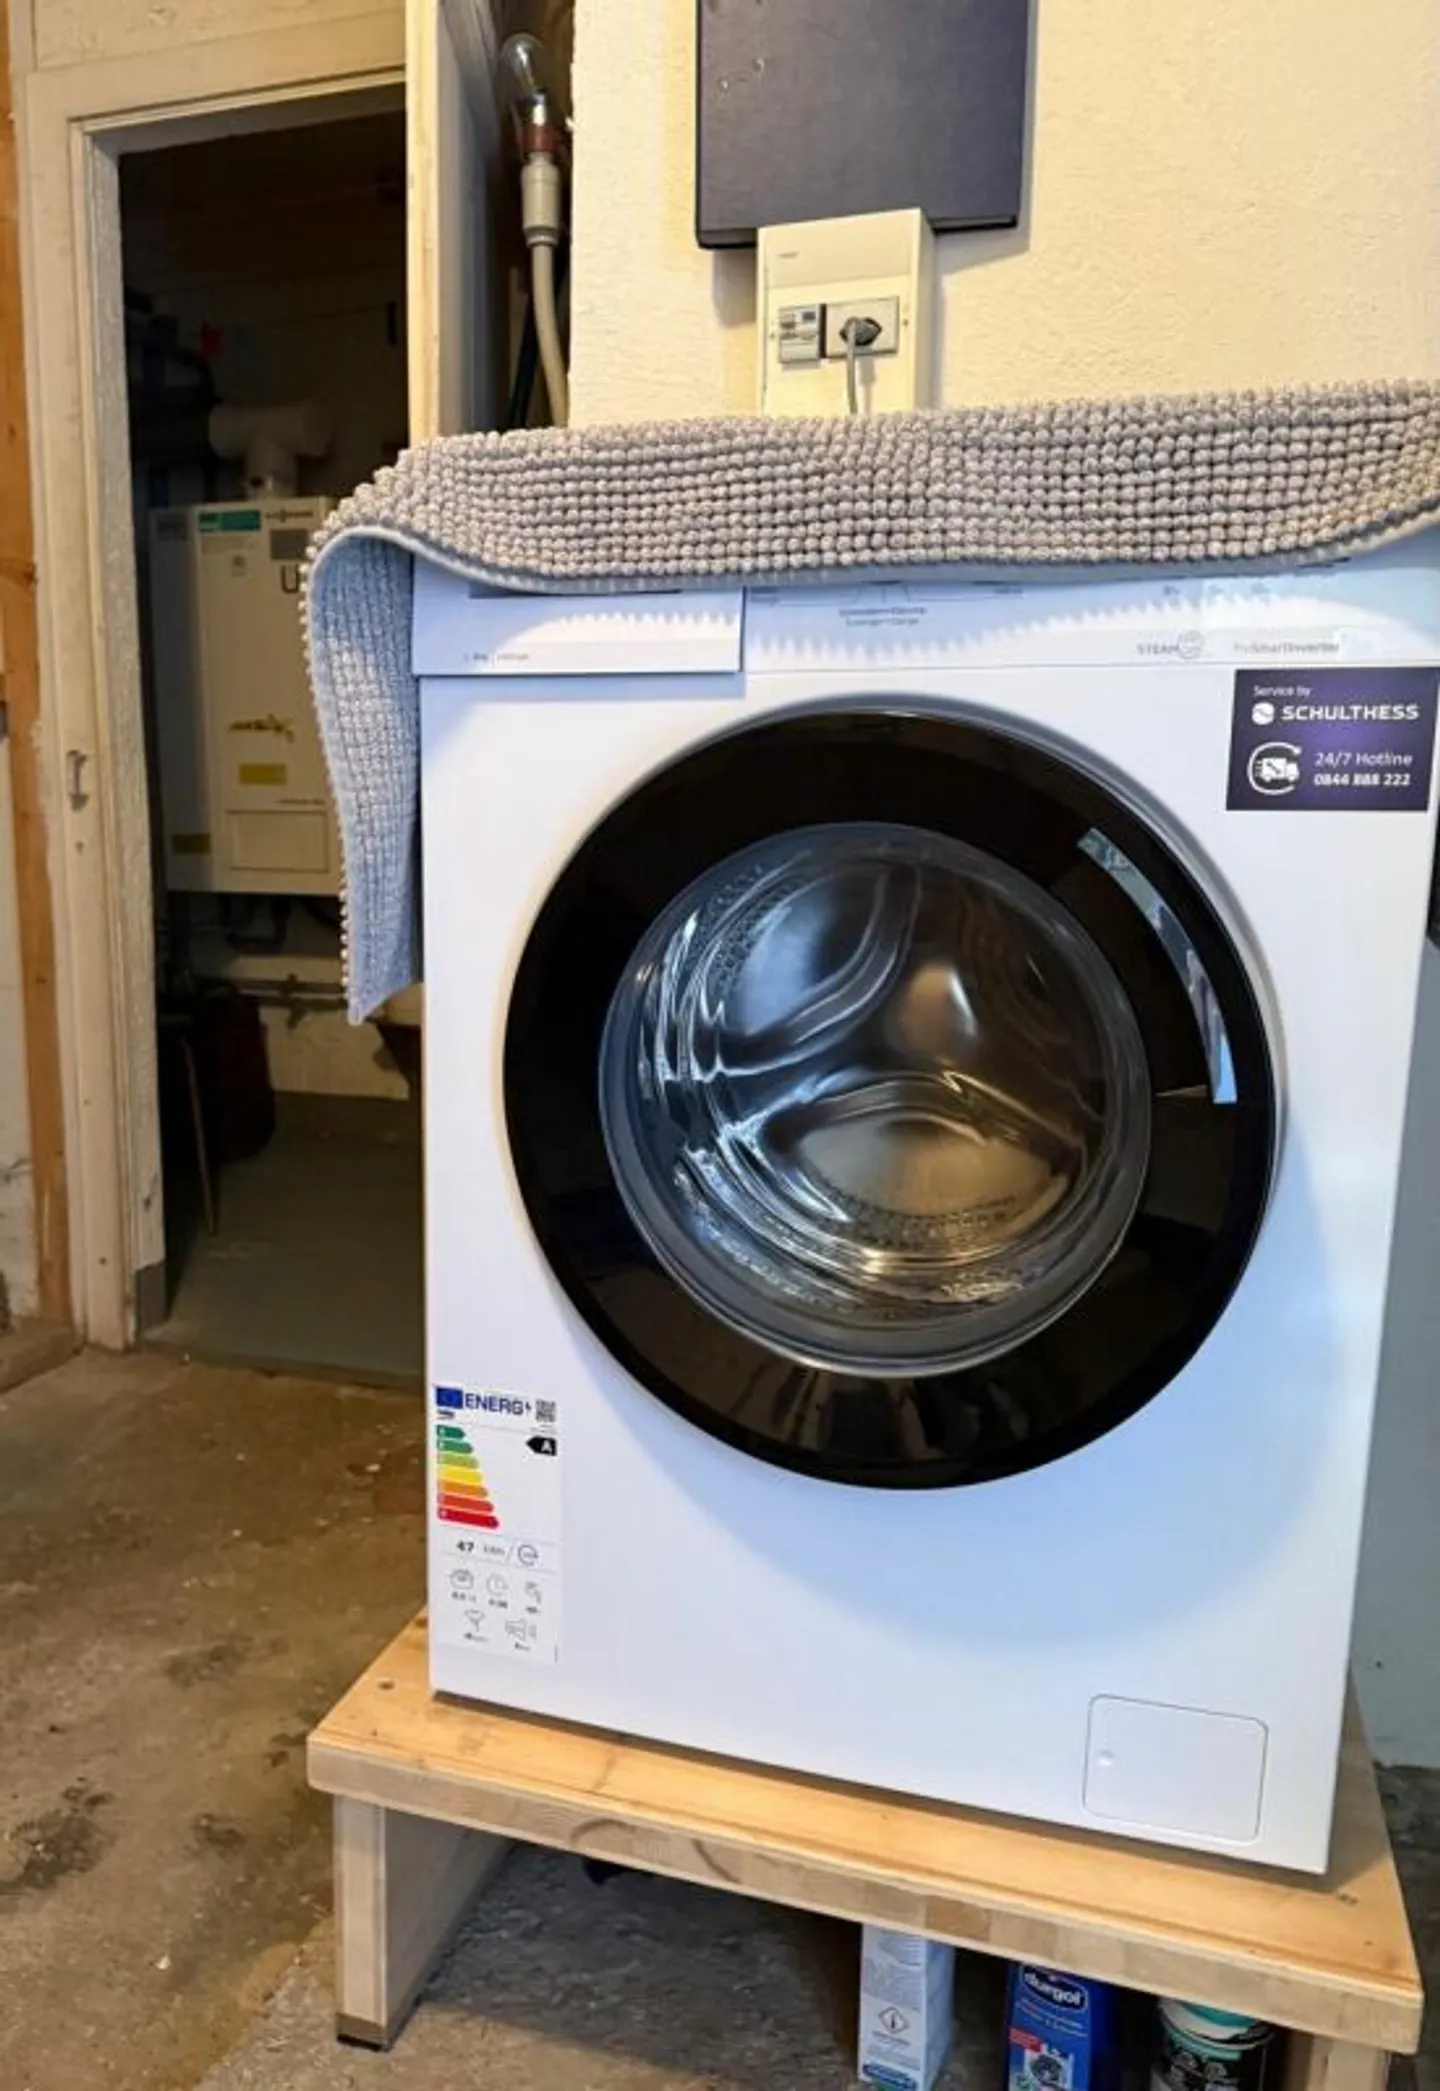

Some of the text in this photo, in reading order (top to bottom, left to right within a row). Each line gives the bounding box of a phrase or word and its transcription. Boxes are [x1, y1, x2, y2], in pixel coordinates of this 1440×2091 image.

[1253, 684, 1312, 698] Service by
[1281, 704, 1420, 720] SCHULTHESS
[1313, 750, 1413, 767] 24/7 Hotline
[1313, 773, 1350, 786] 0844
[1383, 773, 1410, 786] 222
[465, 1393, 524, 1415] ENERG
[540, 1439, 551, 1452] A
